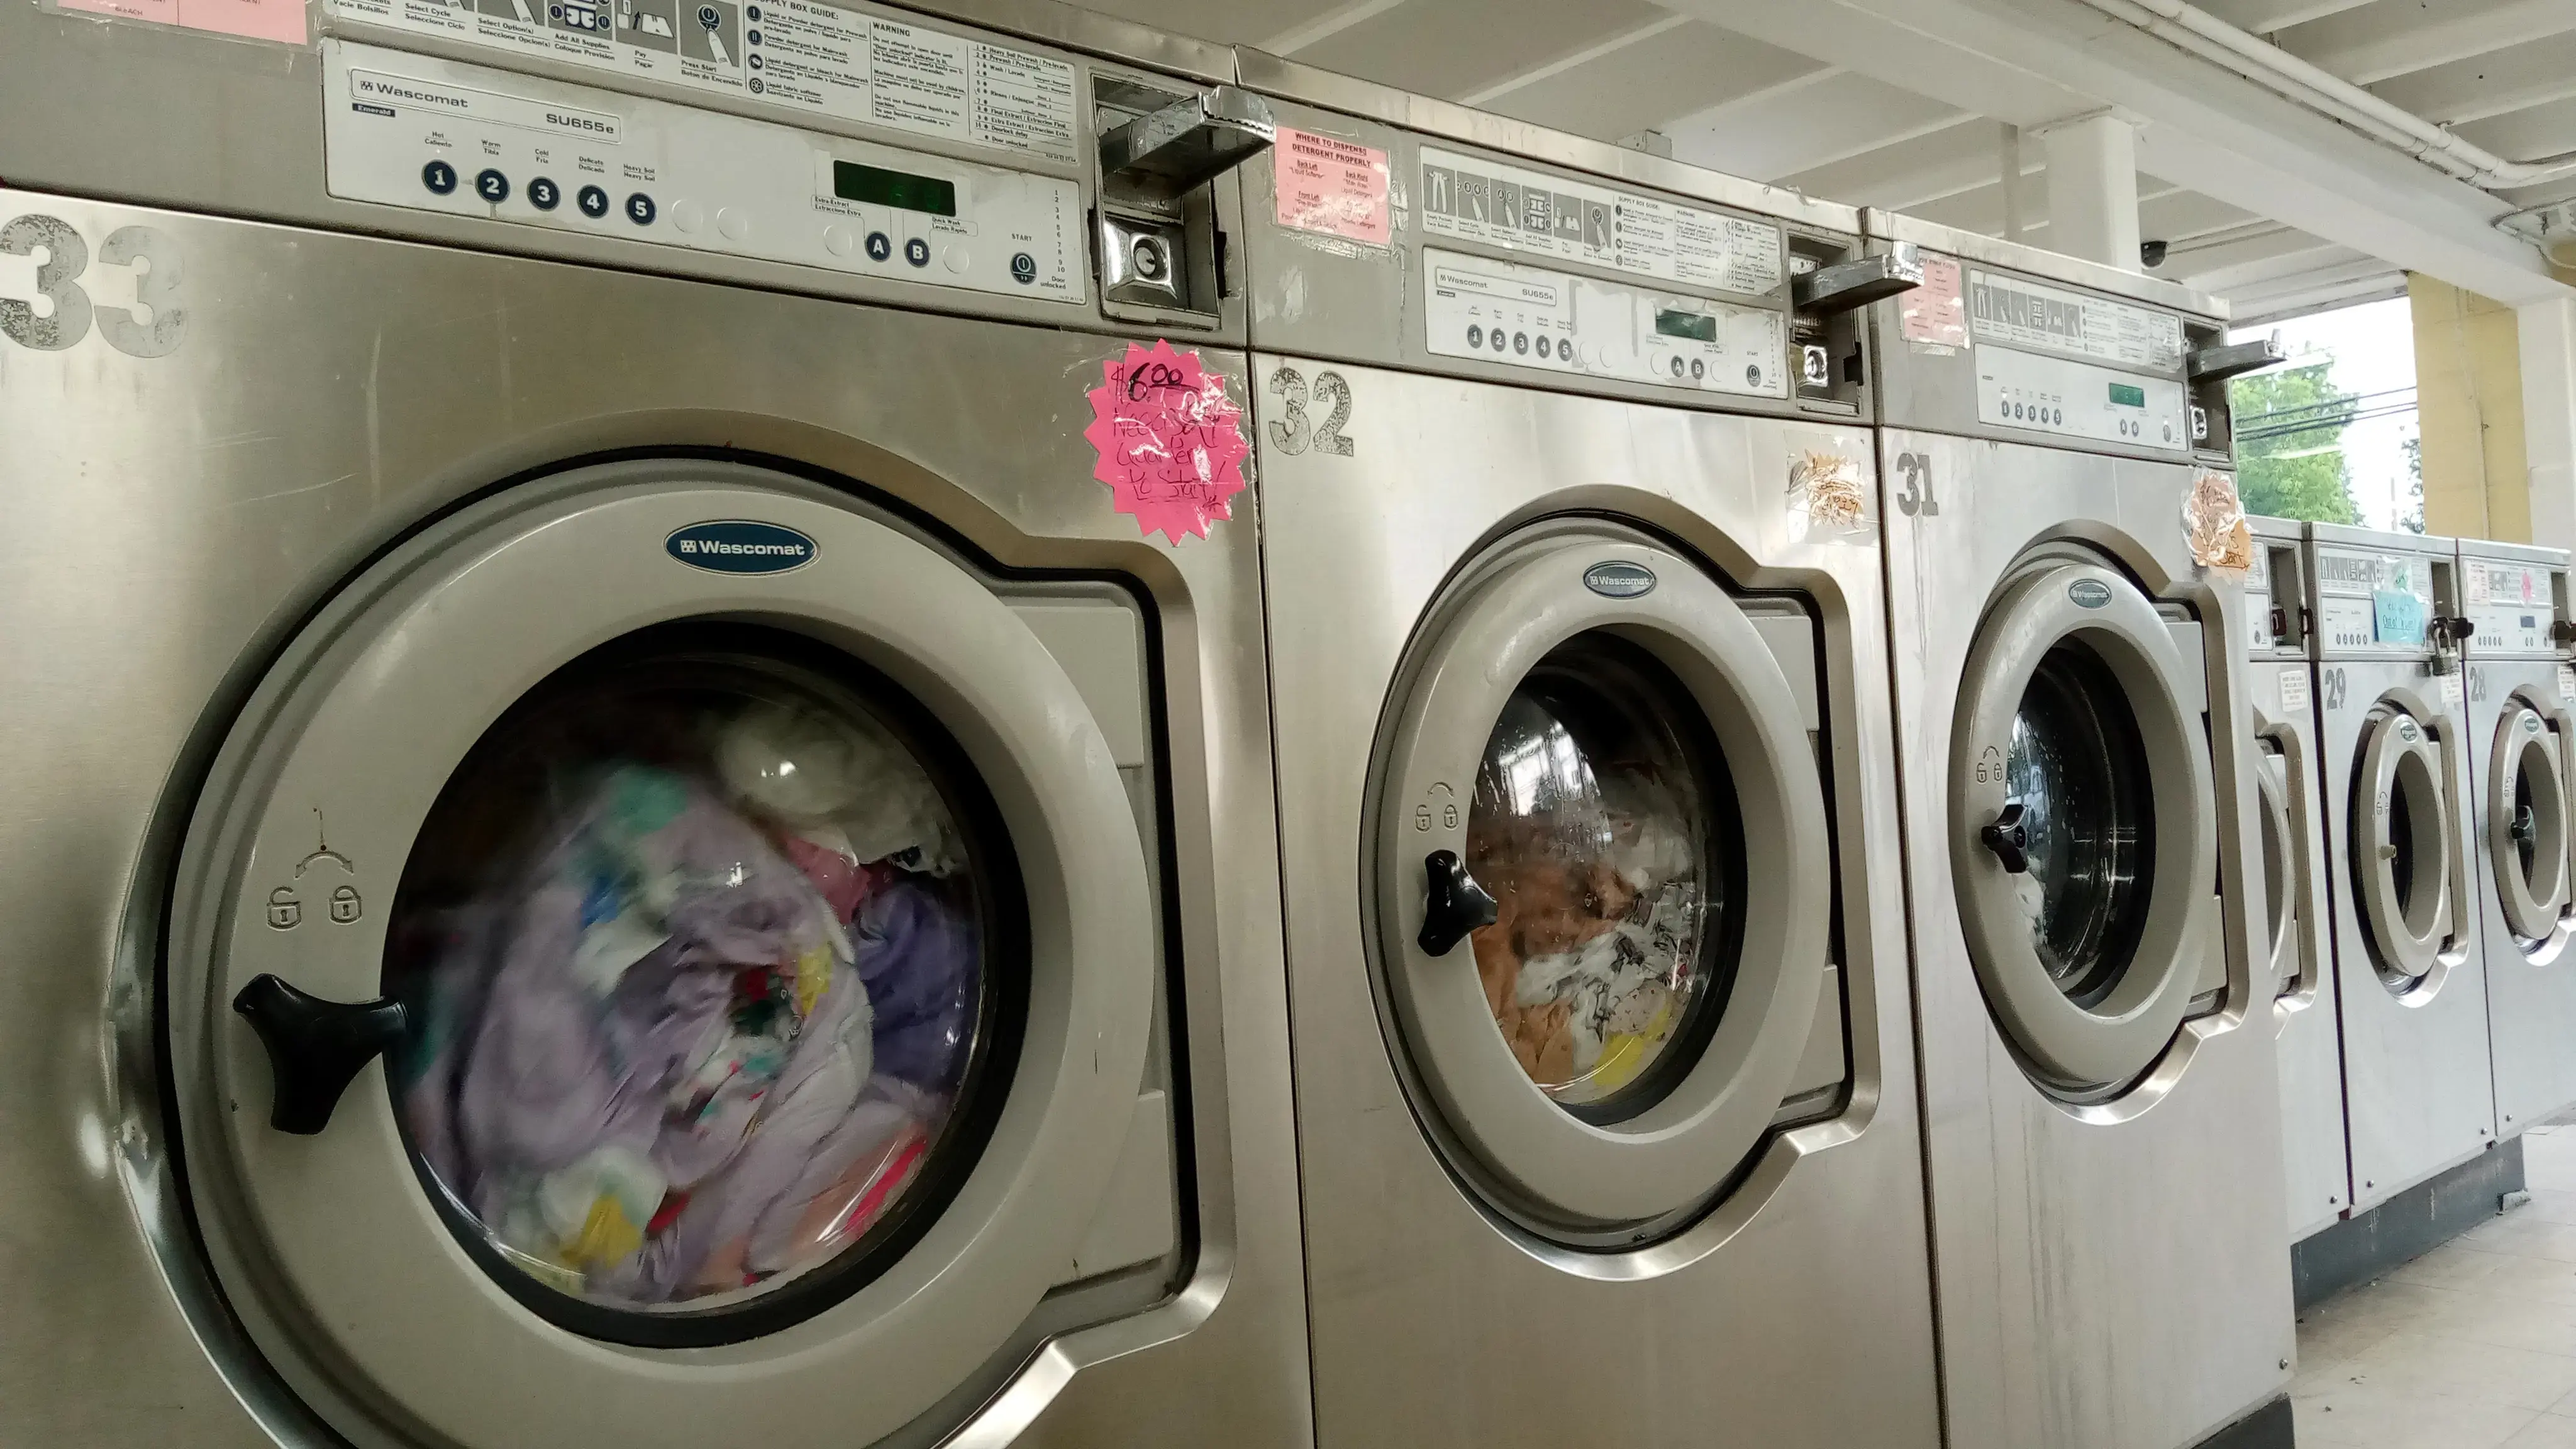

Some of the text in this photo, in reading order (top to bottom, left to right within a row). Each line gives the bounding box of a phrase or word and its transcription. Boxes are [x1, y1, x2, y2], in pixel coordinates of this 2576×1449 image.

[356, 3, 389, 15] Bolsillos
[405, 3, 451, 17] Select Cycle
[790, 2, 808, 13] BOX
[810, 7, 839, 20] GUIDE:
[405, 13, 465, 30] Seleccione Ciclo
[478, 17, 534, 35] Select Option(s)
[872, 21, 911, 37] WARNING
[478, 28, 550, 48] Seleccione Opcion(s)
[555, 33, 610, 50] Add All Supplies
[554, 43, 615, 61] Coloque Provision
[635, 50, 647, 58] Pay
[635, 60, 653, 69] Pagar
[989, 47, 1004, 57] Heavy
[1017, 53, 1038, 63] Prewash
[1043, 60, 1069, 70] Pre-lavado
[989, 53, 1011, 64] Prewash
[1016, 60, 1041, 71] Pre-lavado
[681, 60, 717, 72] Press Start
[681, 69, 700, 79] Boton
[711, 74, 743, 87] Encendido
[1008, 69, 1026, 78] Lavado
[377, 82, 469, 108] Wascomat
[357, 104, 392, 117] Emerald
[546, 112, 615, 135] SU655e
[991, 108, 1003, 116] Final
[1004, 110, 1023, 121] Extract
[1026, 115, 1053, 126] Extraccion
[1053, 120, 1066, 129] Final
[991, 117, 1005, 125] Extra
[1006, 119, 1024, 129] Extract
[1028, 123, 1055, 135] Extraccion
[1055, 130, 1069, 138] Extra
[991, 125, 1029, 139] Doorlock delay
[431, 130, 444, 139] Hot
[1295, 131, 1321, 145] WHERE
[1323, 138, 1332, 147] TO
[425, 138, 453, 148] Caliente
[481, 138, 501, 148] Warm
[1005, 138, 1028, 148] unlocked
[484, 147, 499, 156] Tibia
[534, 147, 550, 157] Cold
[1292, 143, 1372, 168] DETERGENT PROPERLY
[535, 155, 549, 164] Fria
[578, 155, 604, 167] Delicate
[1297, 159, 1319, 171] Back Left
[578, 163, 606, 174] Delicado
[623, 162, 655, 175] Heavy Soil
[434, 169, 446, 186] 1
[623, 170, 655, 182] Heavy Soil
[1345, 170, 1356, 180] Back
[486, 177, 500, 194] 2
[537, 186, 550, 202] 3
[1298, 190, 1311, 201] Front
[1354, 189, 1373, 199] Detergent
[586, 193, 600, 209] 4
[815, 196, 850, 208] Extra Extract
[634, 200, 647, 218] 5
[847, 209, 862, 217] Extra
[947, 218, 961, 226] Wash
[931, 223, 968, 235] Lavado Rapido
[1011, 233, 1033, 242] START
[873, 239, 885, 254] A
[912, 245, 924, 259] B
[0, 213, 189, 358] 33
[1040, 281, 1067, 290] unlocked
[1052, 275, 1065, 284] Door
[1447, 275, 1489, 289] Wascomat
[1522, 288, 1554, 301] SU655e
[1473, 330, 1479, 342] 1
[1496, 335, 1502, 345] 2
[1518, 337, 1524, 348] 3
[1540, 341, 1546, 352] 4
[1562, 345, 1568, 355] 5
[1675, 360, 1682, 372] A
[1695, 364, 1701, 374] B
[1269, 367, 1354, 458] 32
[1896, 452, 1939, 517] 31
[698, 539, 805, 556] Wascomat
[1598, 575, 1650, 586] Wascomat
[2324, 667, 2346, 711] 29
